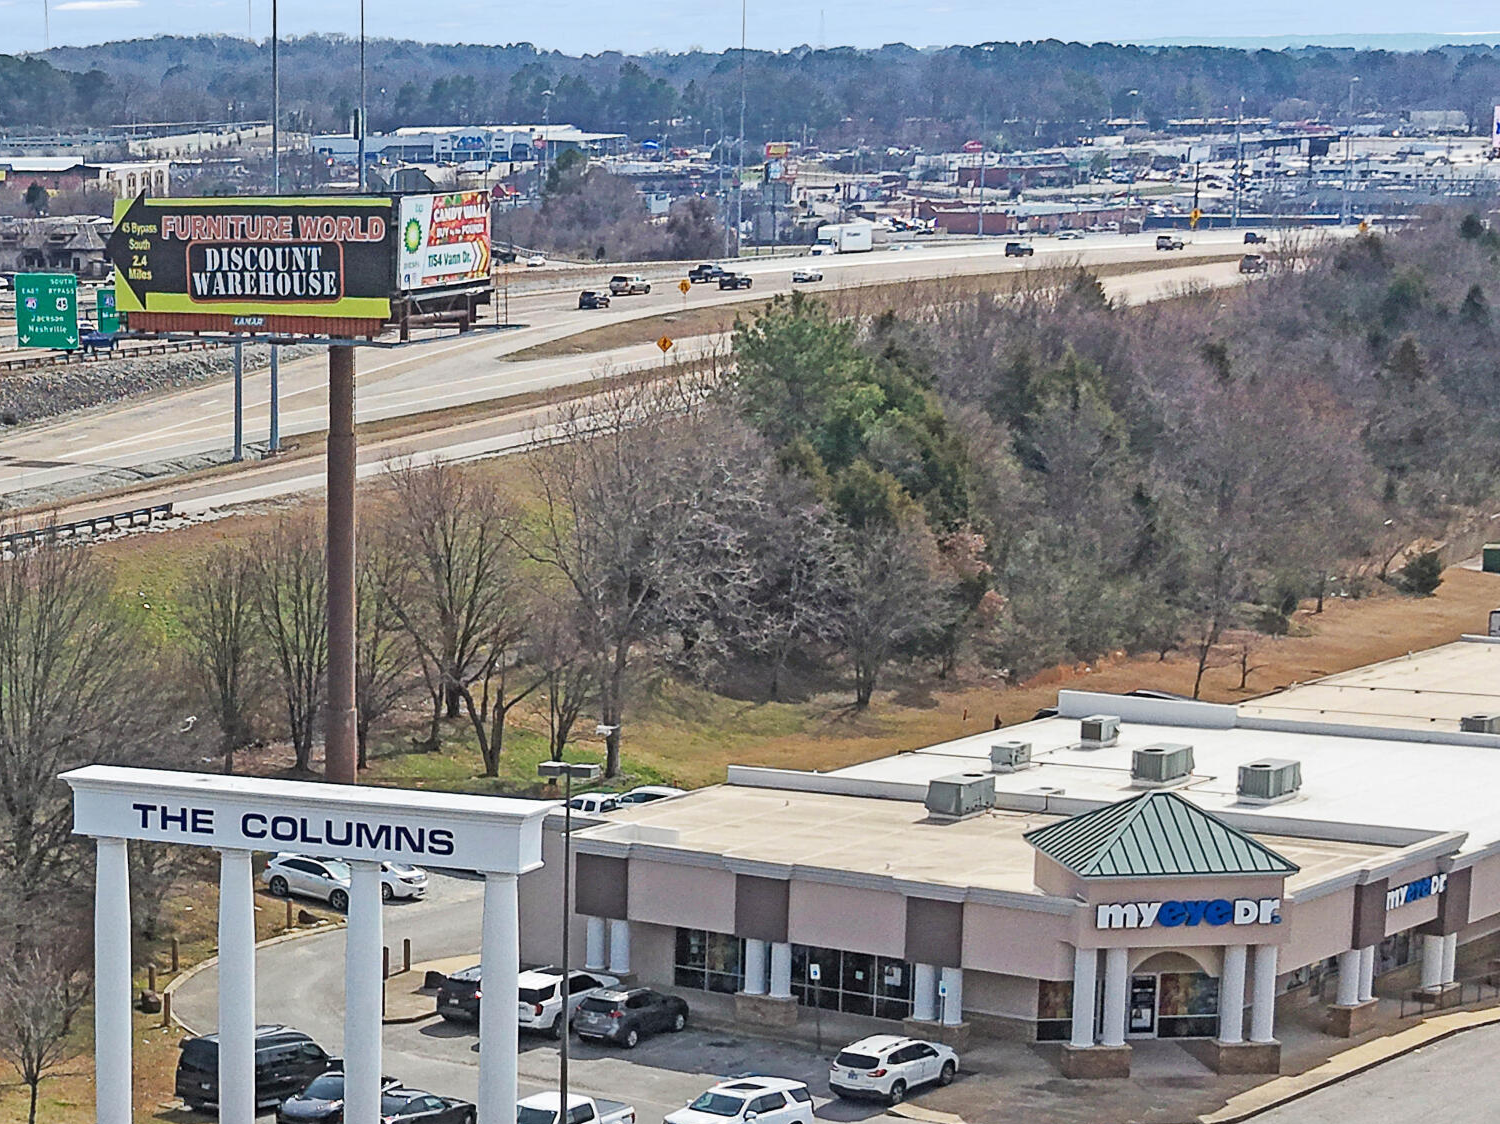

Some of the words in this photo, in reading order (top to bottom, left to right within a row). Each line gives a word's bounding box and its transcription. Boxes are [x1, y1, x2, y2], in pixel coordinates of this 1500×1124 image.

[433, 206, 462, 223] CANDY
[463, 204, 487, 219] WALL
[131, 222, 158, 236] Bypass
[161, 214, 294, 241] FURNITURE
[298, 214, 386, 242] WORLD
[128, 238, 151, 250] South
[132, 254, 148, 267] 2.4
[204, 246, 322, 272] DISCOUNT
[443, 252, 461, 265] Vann
[128, 267, 152, 280] Miles
[191, 270, 337, 296] WAREHOUSE
[31, 314, 64, 322] Jackson
[234, 317, 263, 326] LAMAR
[28, 325, 67, 333] Nashville
[132, 803, 215, 835] THE
[240, 813, 455, 856] COLUMNS
